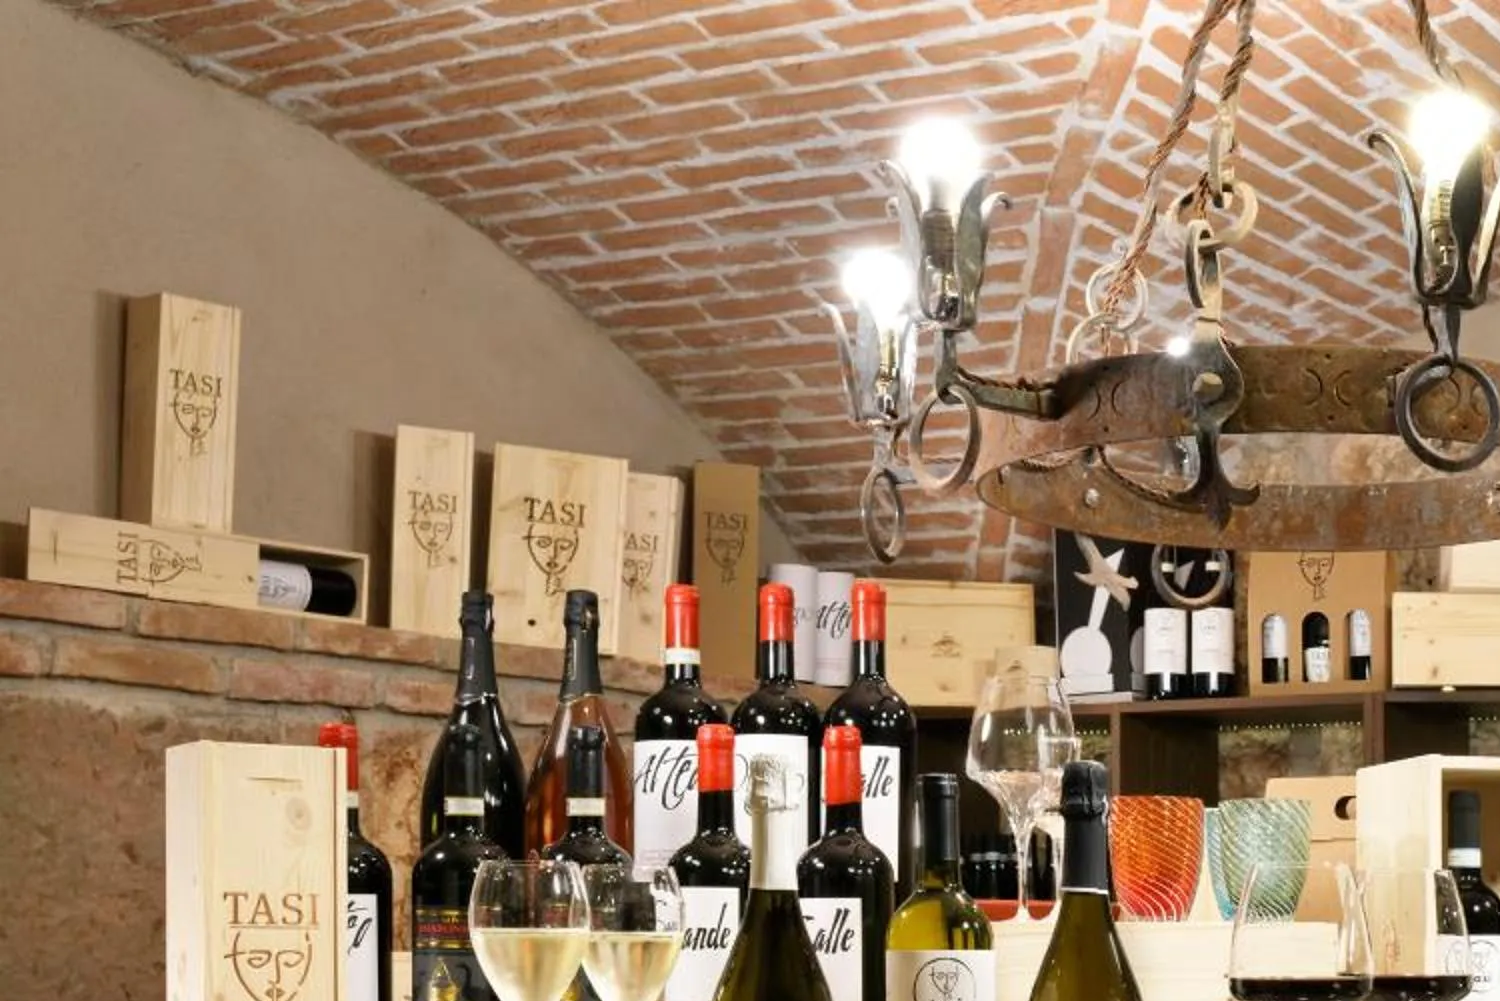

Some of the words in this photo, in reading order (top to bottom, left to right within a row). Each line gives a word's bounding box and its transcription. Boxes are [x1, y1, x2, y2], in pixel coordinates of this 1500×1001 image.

[169, 369, 222, 398] TASI
[408, 490, 457, 514] TASI
[523, 497, 587, 528] TASI
[703, 511, 749, 530] TASI
[116, 531, 140, 584] TASI
[622, 533, 658, 552] ASI
[862, 756, 893, 798] lle
[224, 892, 320, 926] TASI
[681, 902, 731, 950] ande
[801, 908, 854, 953] alle
